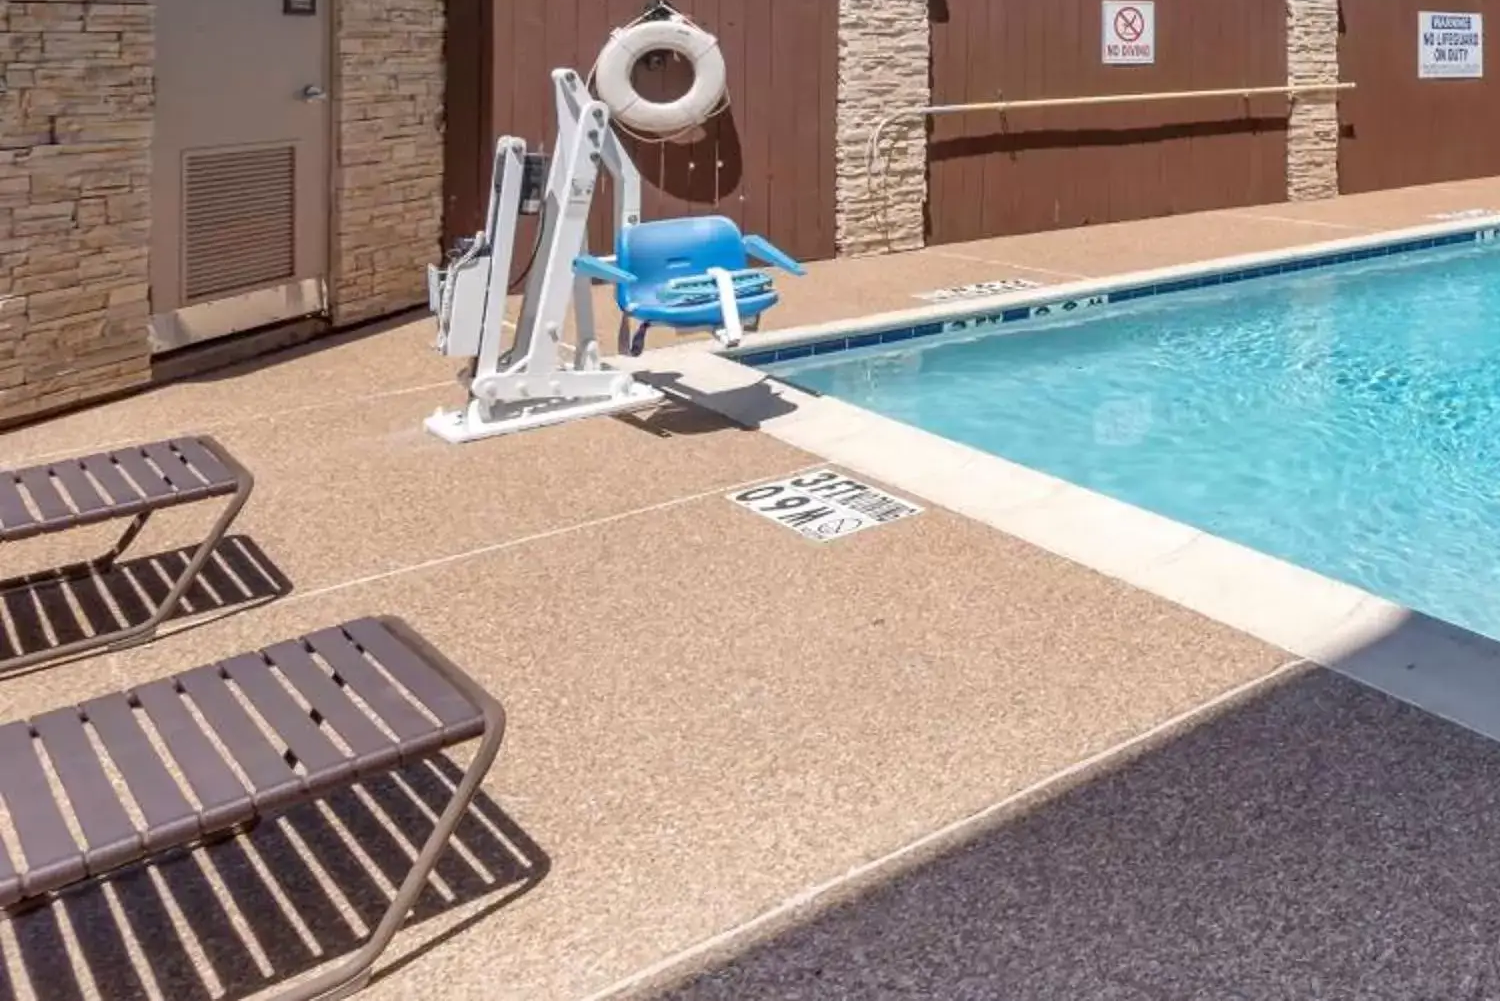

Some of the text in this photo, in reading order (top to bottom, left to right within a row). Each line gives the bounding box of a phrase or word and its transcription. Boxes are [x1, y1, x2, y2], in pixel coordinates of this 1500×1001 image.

[1424, 32, 1479, 46] NO LIFEGUARD
[1107, 44, 1150, 57] NO DIVING
[1434, 48, 1468, 61] ON DUTY
